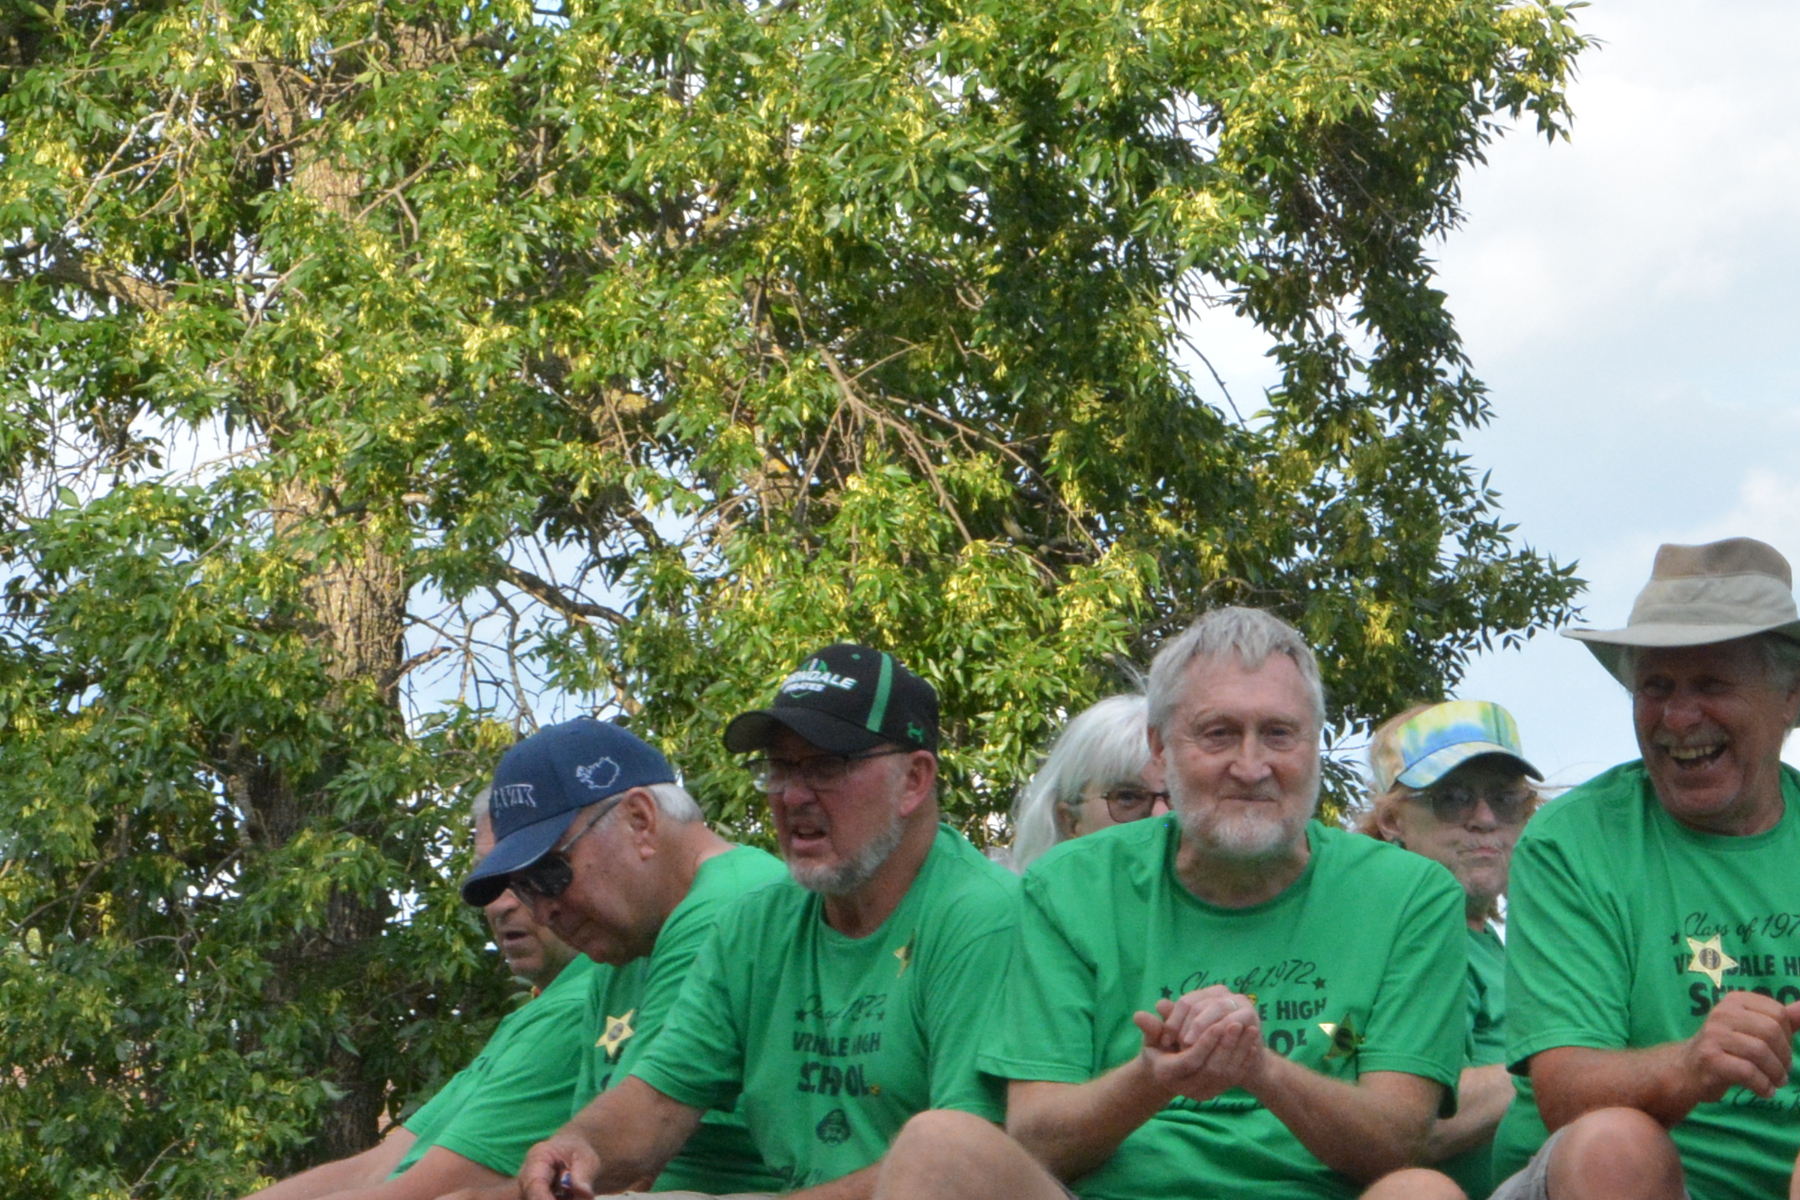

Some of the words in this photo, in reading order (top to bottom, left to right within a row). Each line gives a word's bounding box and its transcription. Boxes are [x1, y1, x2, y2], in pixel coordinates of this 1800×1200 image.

[1685, 912, 1728, 937] Class
[1736, 917, 1758, 944] of
[1234, 967, 1260, 994] of
[1260, 959, 1316, 987] 1972
[1276, 998, 1327, 1020] HIGH
